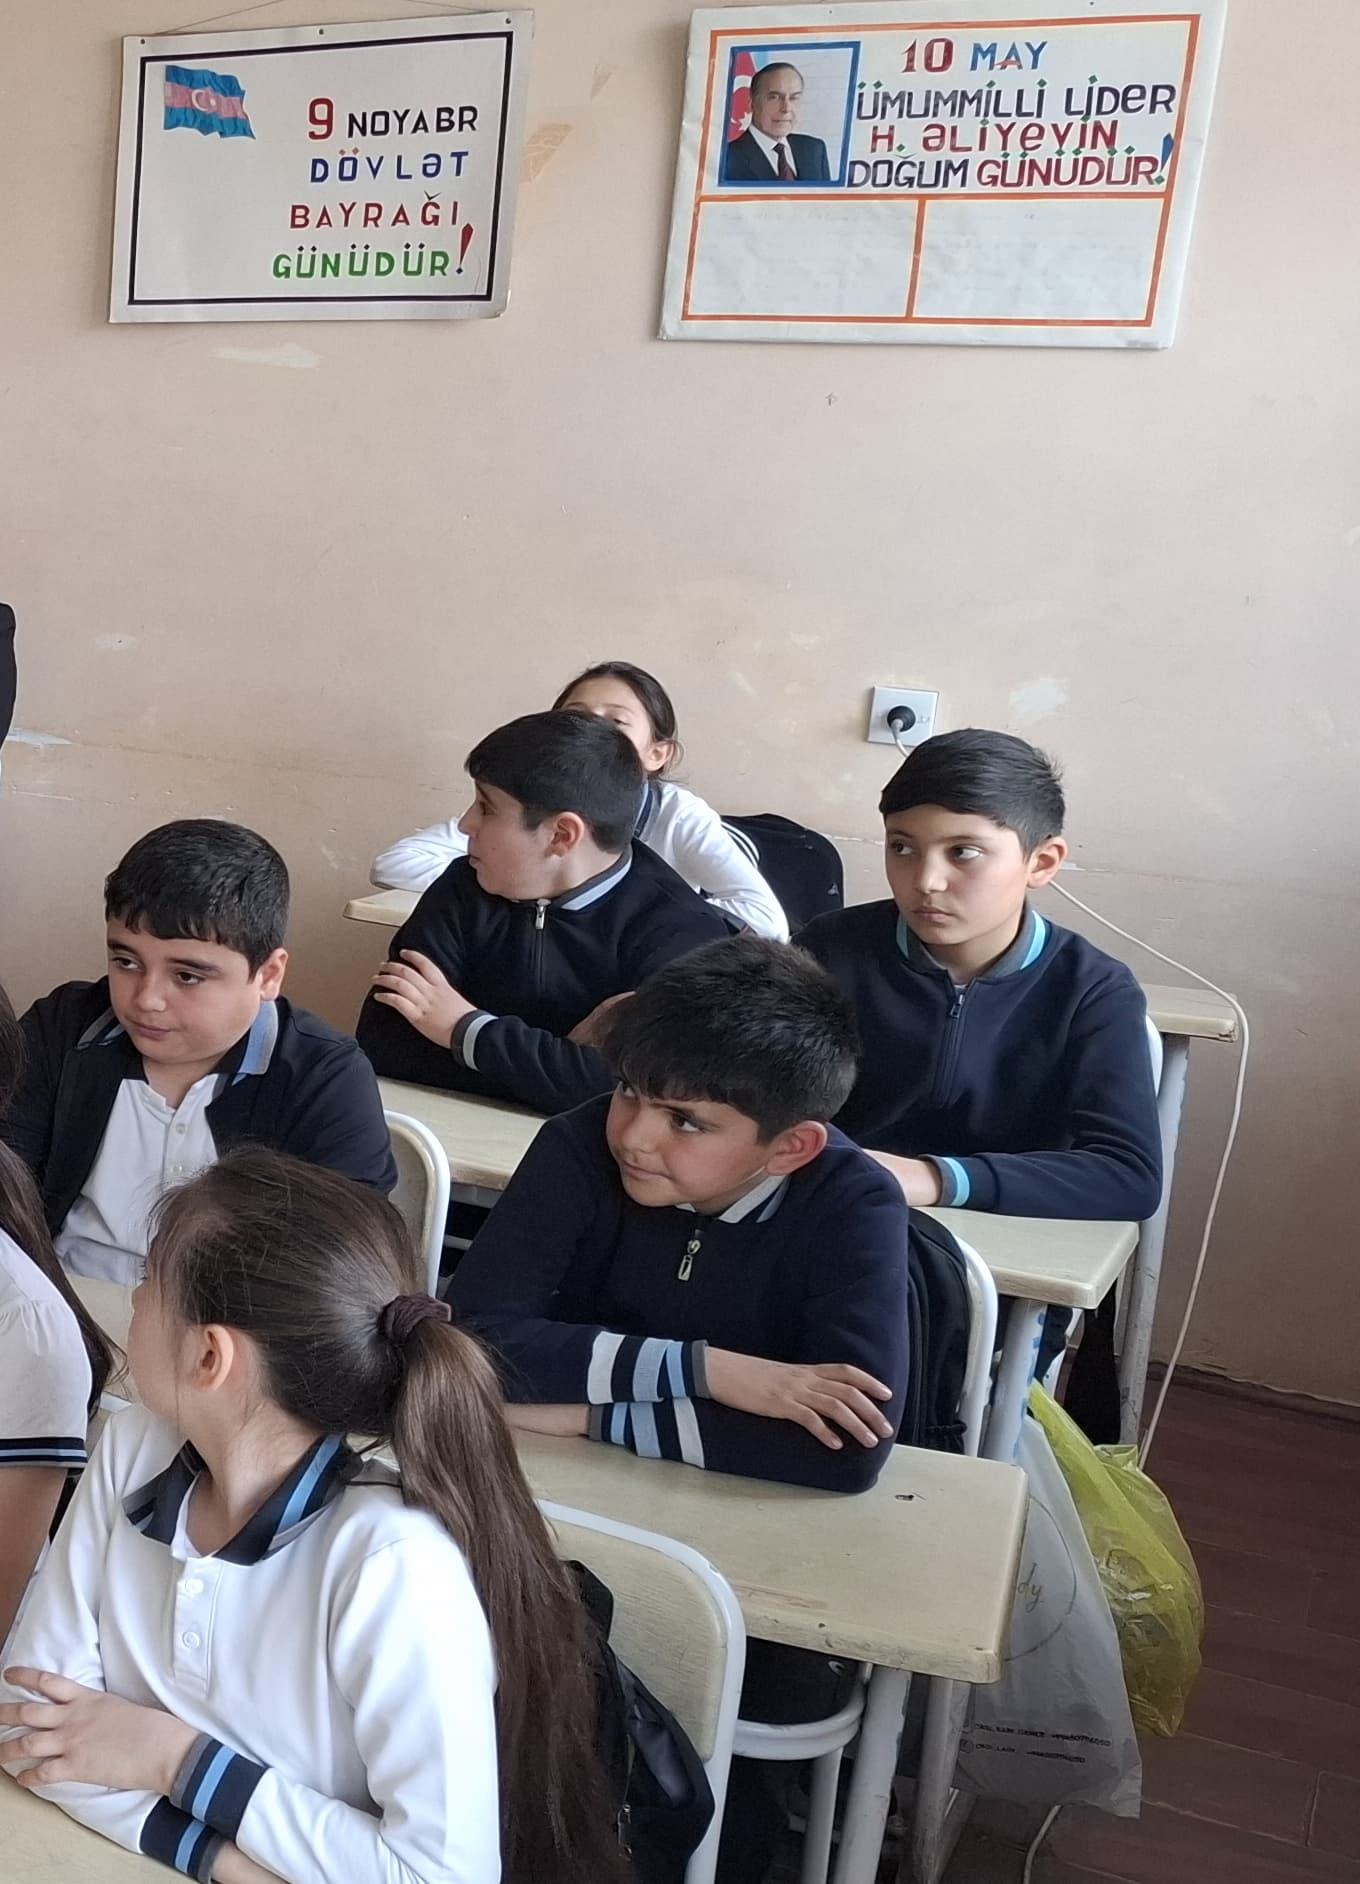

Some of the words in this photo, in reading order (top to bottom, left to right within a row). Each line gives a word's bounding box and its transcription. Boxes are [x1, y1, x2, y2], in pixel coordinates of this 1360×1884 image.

[901, 38, 954, 73] 10
[970, 41, 1048, 71] MAY
[308, 98, 334, 141] 9
[347, 105, 478, 139] NOYABR
[857, 79, 1048, 121] ÜMUMMİLLİ
[870, 125, 906, 153] H.
[310, 147, 469, 183] DÖVLƏT
[847, 153, 969, 189] DOĞUM
[977, 132, 1175, 188] GÜNÜDÜR!
[290, 191, 459, 230] BAYRAĞI
[272, 223, 475, 279] GÜNÜDÜR!
